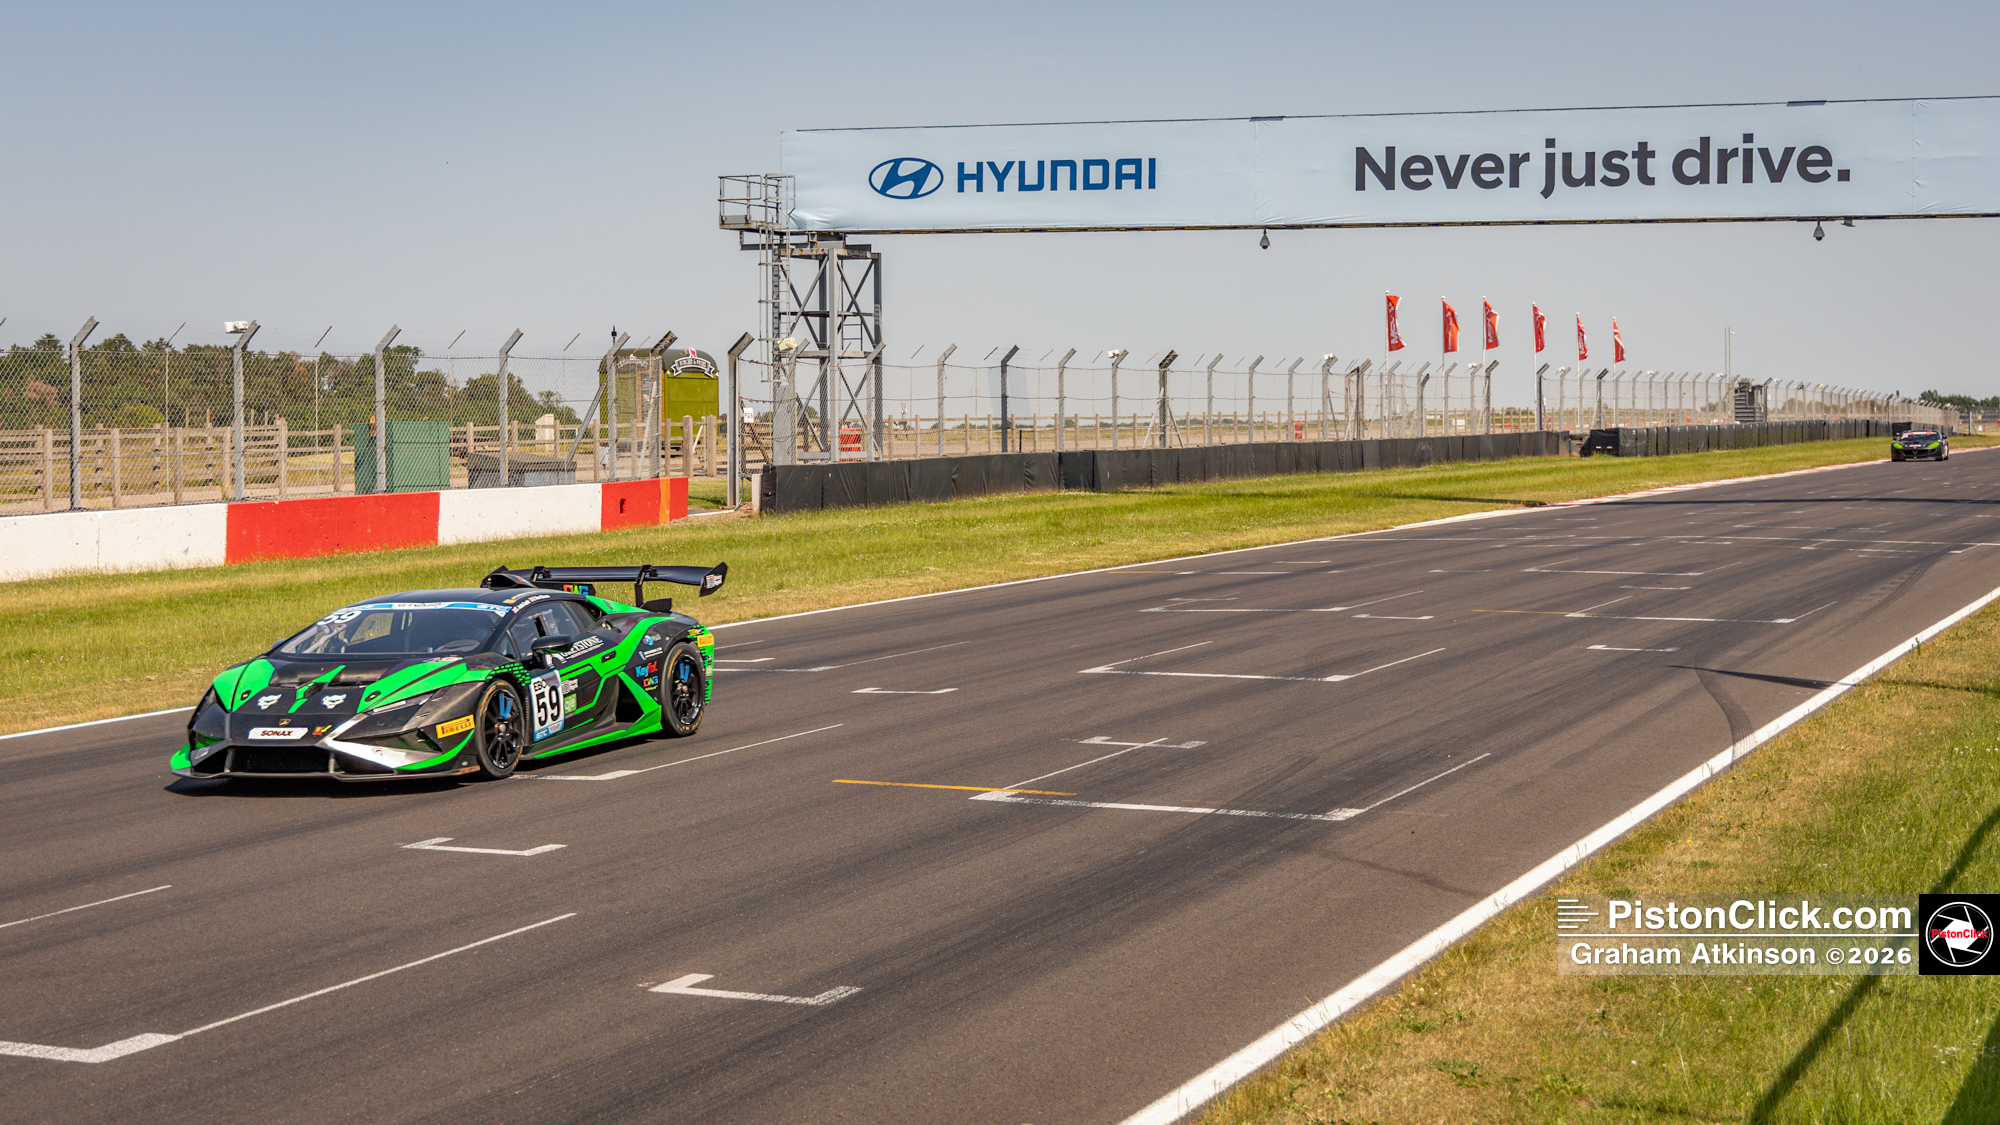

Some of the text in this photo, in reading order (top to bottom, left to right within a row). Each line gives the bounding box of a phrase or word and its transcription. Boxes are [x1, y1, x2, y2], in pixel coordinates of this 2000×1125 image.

[958, 157, 1156, 193] HYUNDAI
[1356, 133, 1850, 199] Never just drive.
[317, 610, 363, 626] 59
[536, 685, 561, 727] 59
[442, 719, 471, 734] PIRELLI
